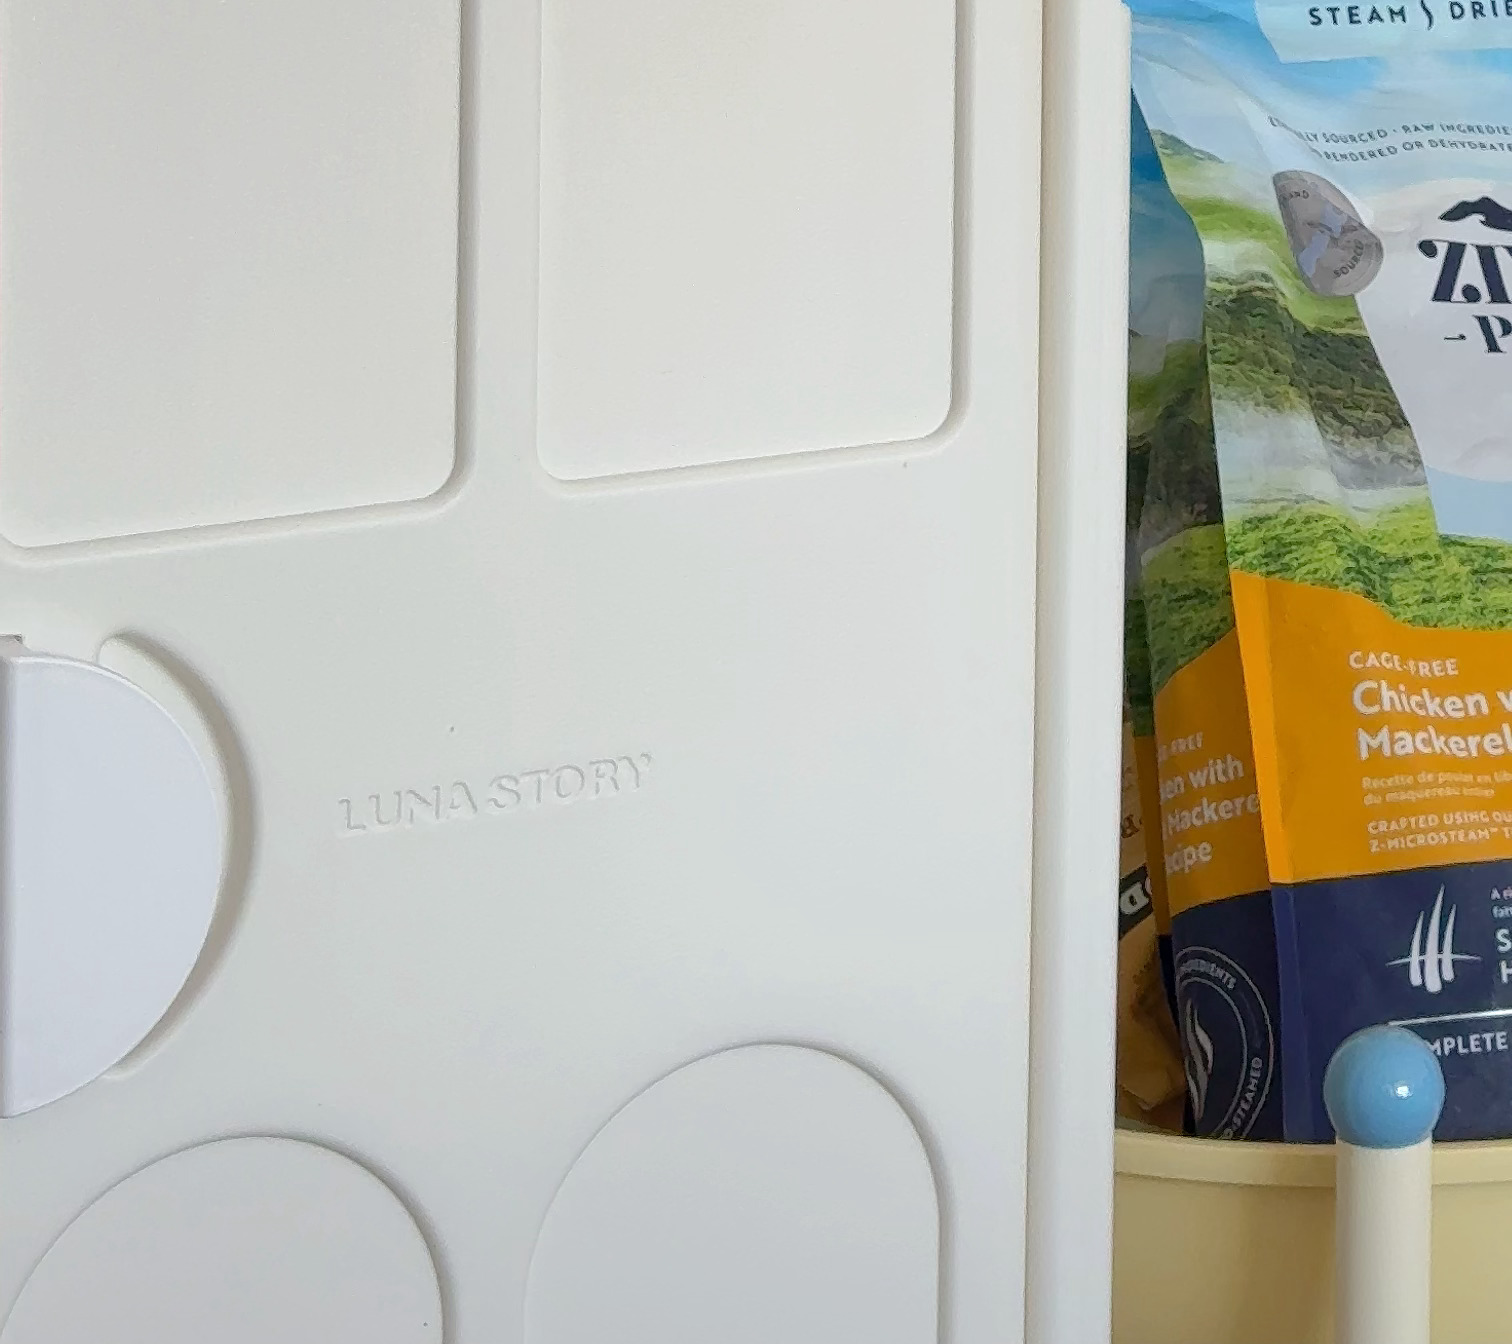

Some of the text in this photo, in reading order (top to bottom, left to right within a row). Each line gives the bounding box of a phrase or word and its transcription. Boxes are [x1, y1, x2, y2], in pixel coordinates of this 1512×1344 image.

[1307, 4, 1408, 27] STEAM
[1401, 121, 1435, 135] RAW
[1402, 140, 1424, 152] OR
[1351, 678, 1490, 720] Chicken
[337, 752, 654, 834] LUNA STORY
[1165, 792, 1261, 838] Mackere
[1366, 812, 1439, 836] CRAFTED
[1442, 808, 1490, 826] USING
[1425, 1029, 1509, 1058] MPLETE
